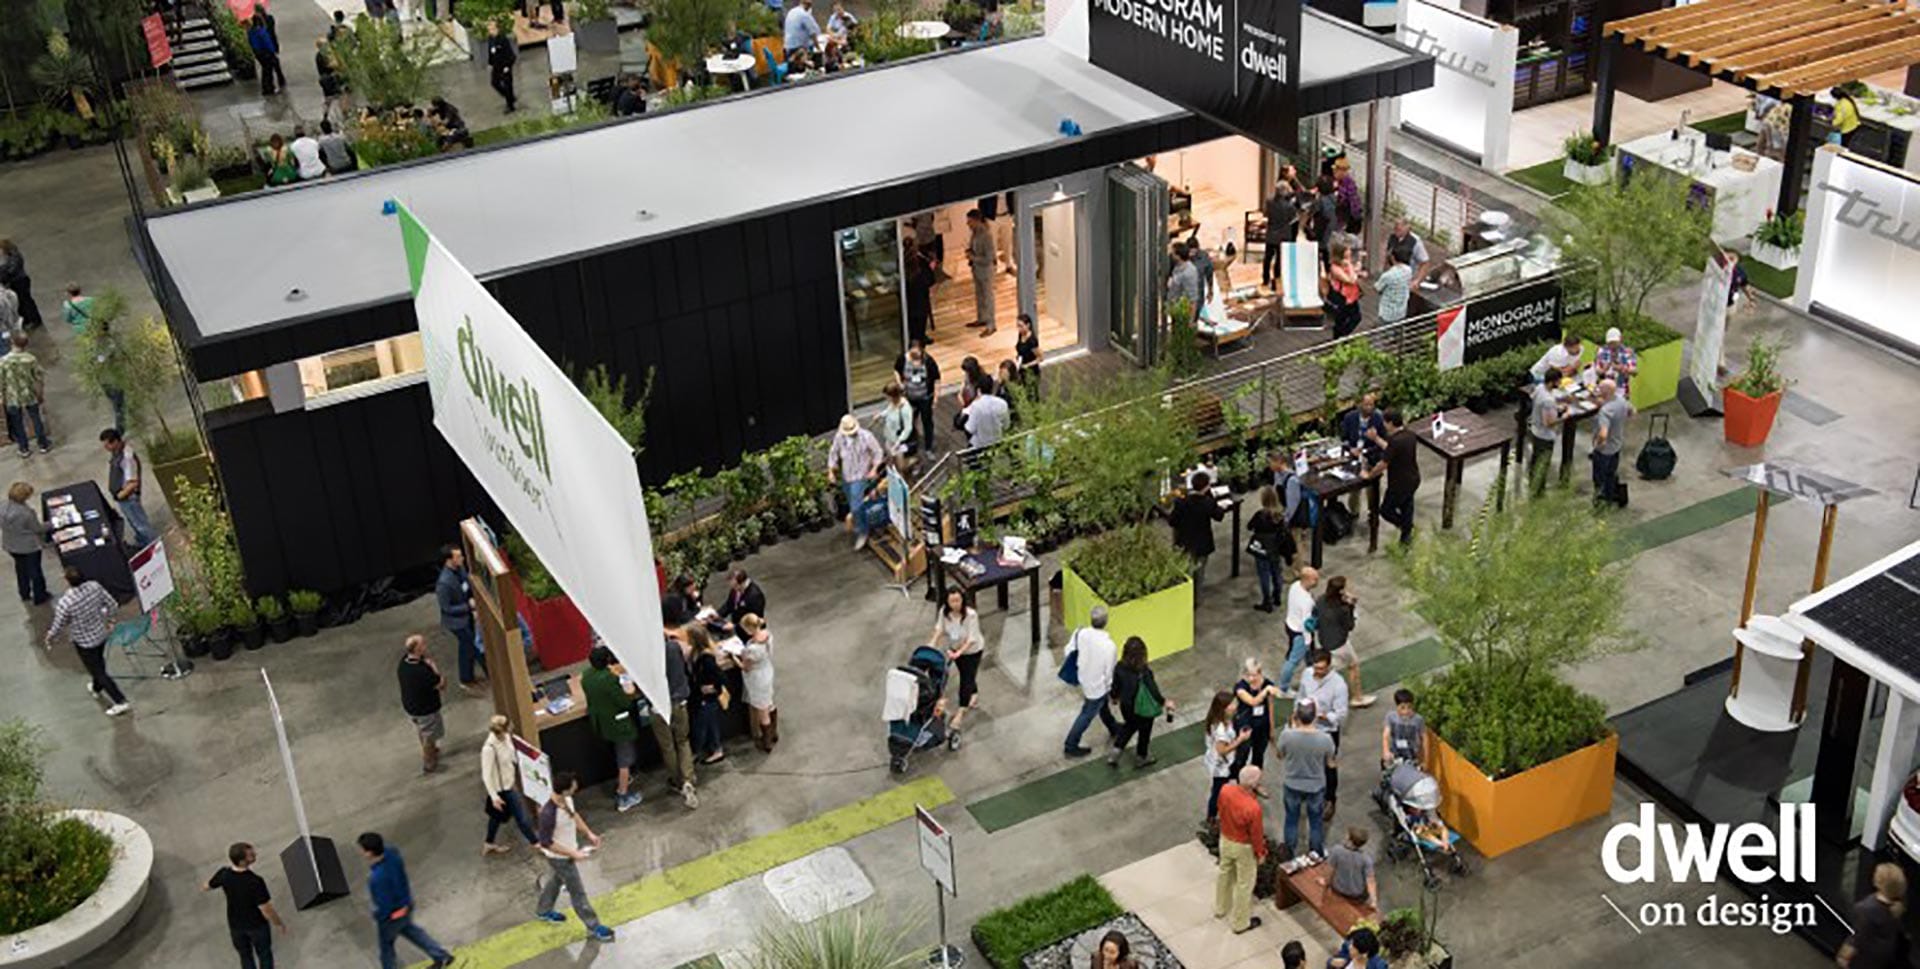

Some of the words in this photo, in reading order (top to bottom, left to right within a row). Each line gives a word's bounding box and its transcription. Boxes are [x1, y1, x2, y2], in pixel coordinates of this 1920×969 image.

[1145, 0, 1223, 33] GRAM
[1170, 18, 1225, 61] HOME
[1401, 24, 1496, 87] true
[1241, 41, 1287, 84] dwell
[1466, 320, 1518, 347] MODERN
[1467, 297, 1556, 335] MONOGRAM
[457, 314, 552, 487] dwell
